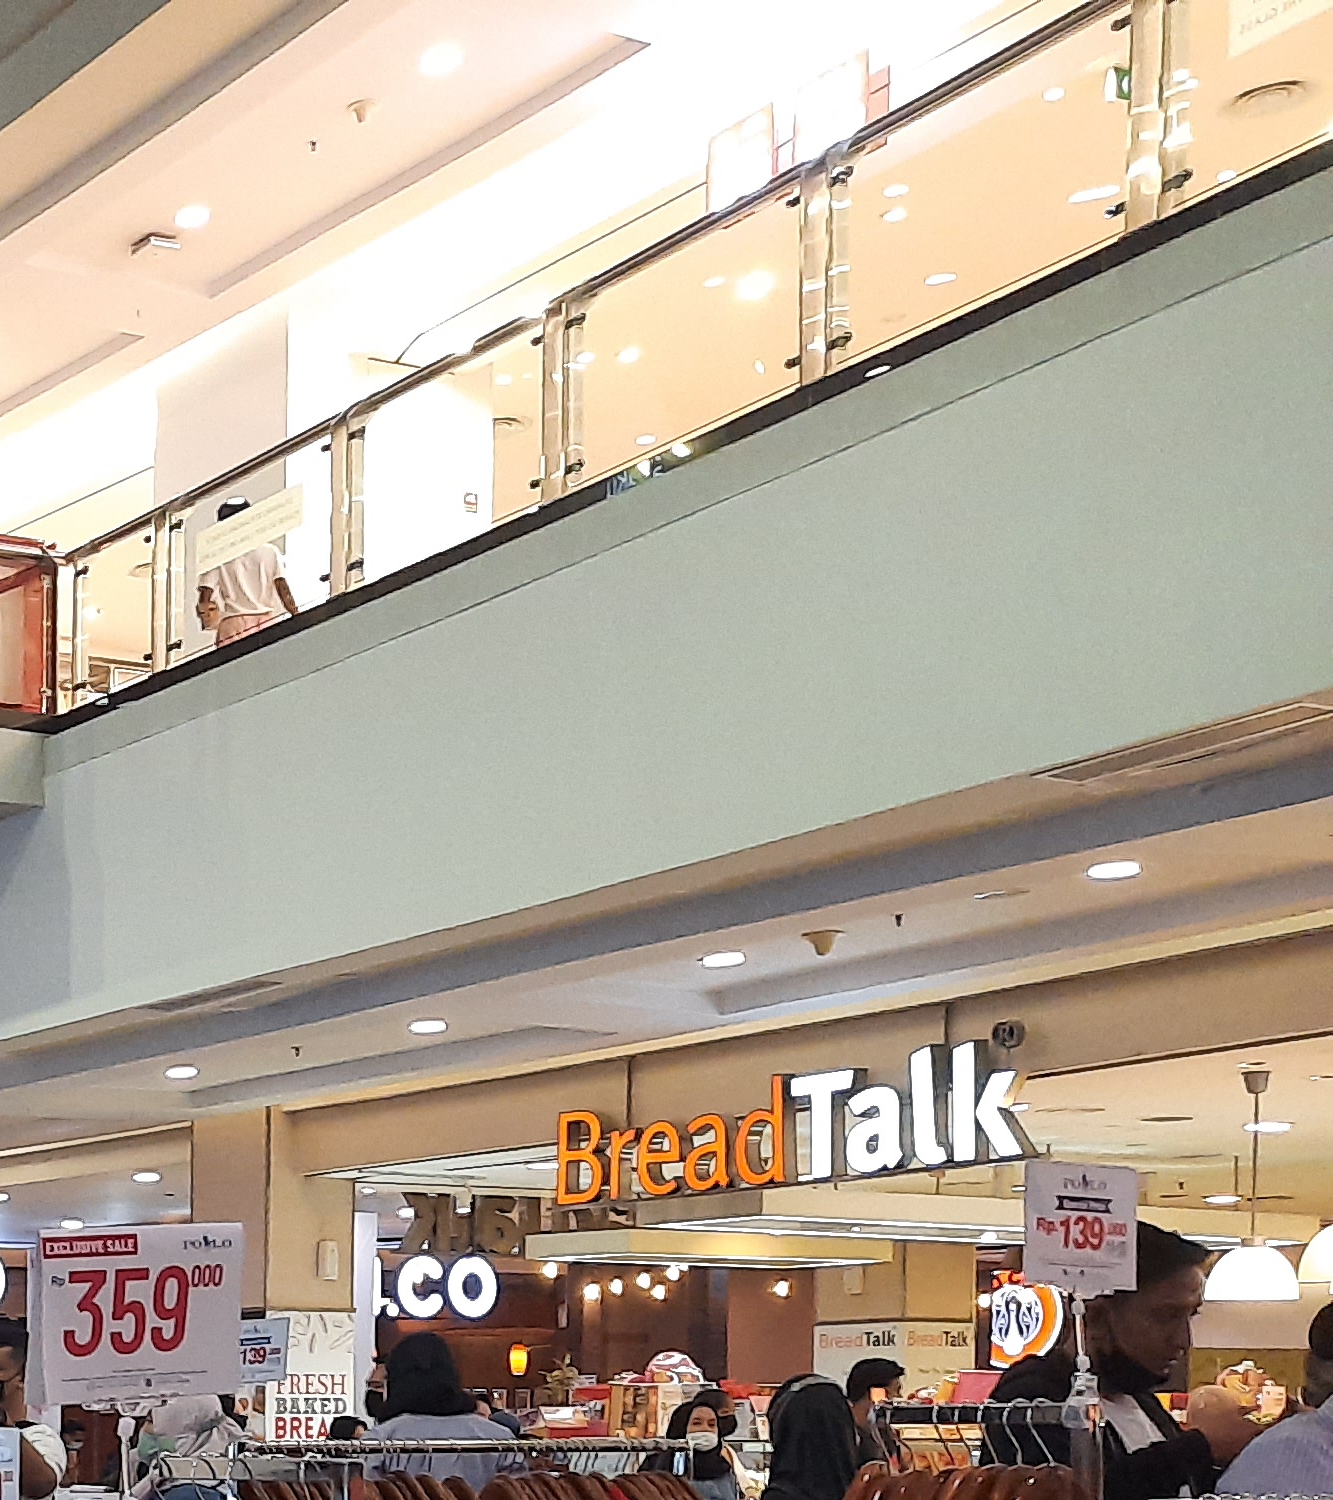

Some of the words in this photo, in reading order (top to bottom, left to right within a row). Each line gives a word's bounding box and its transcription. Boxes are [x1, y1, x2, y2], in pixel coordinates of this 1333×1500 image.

[556, 1040, 1024, 1206] BreadTalk
[1059, 1215, 1105, 1251] 139
[106, 1238, 136, 1252] SALE
[63, 1265, 191, 1358] 359
[819, 1329, 897, 1349] BreadTalk
[276, 1373, 348, 1396] FRESH
[275, 1397, 348, 1415] BAKED
[275, 1416, 330, 1440] BREA
